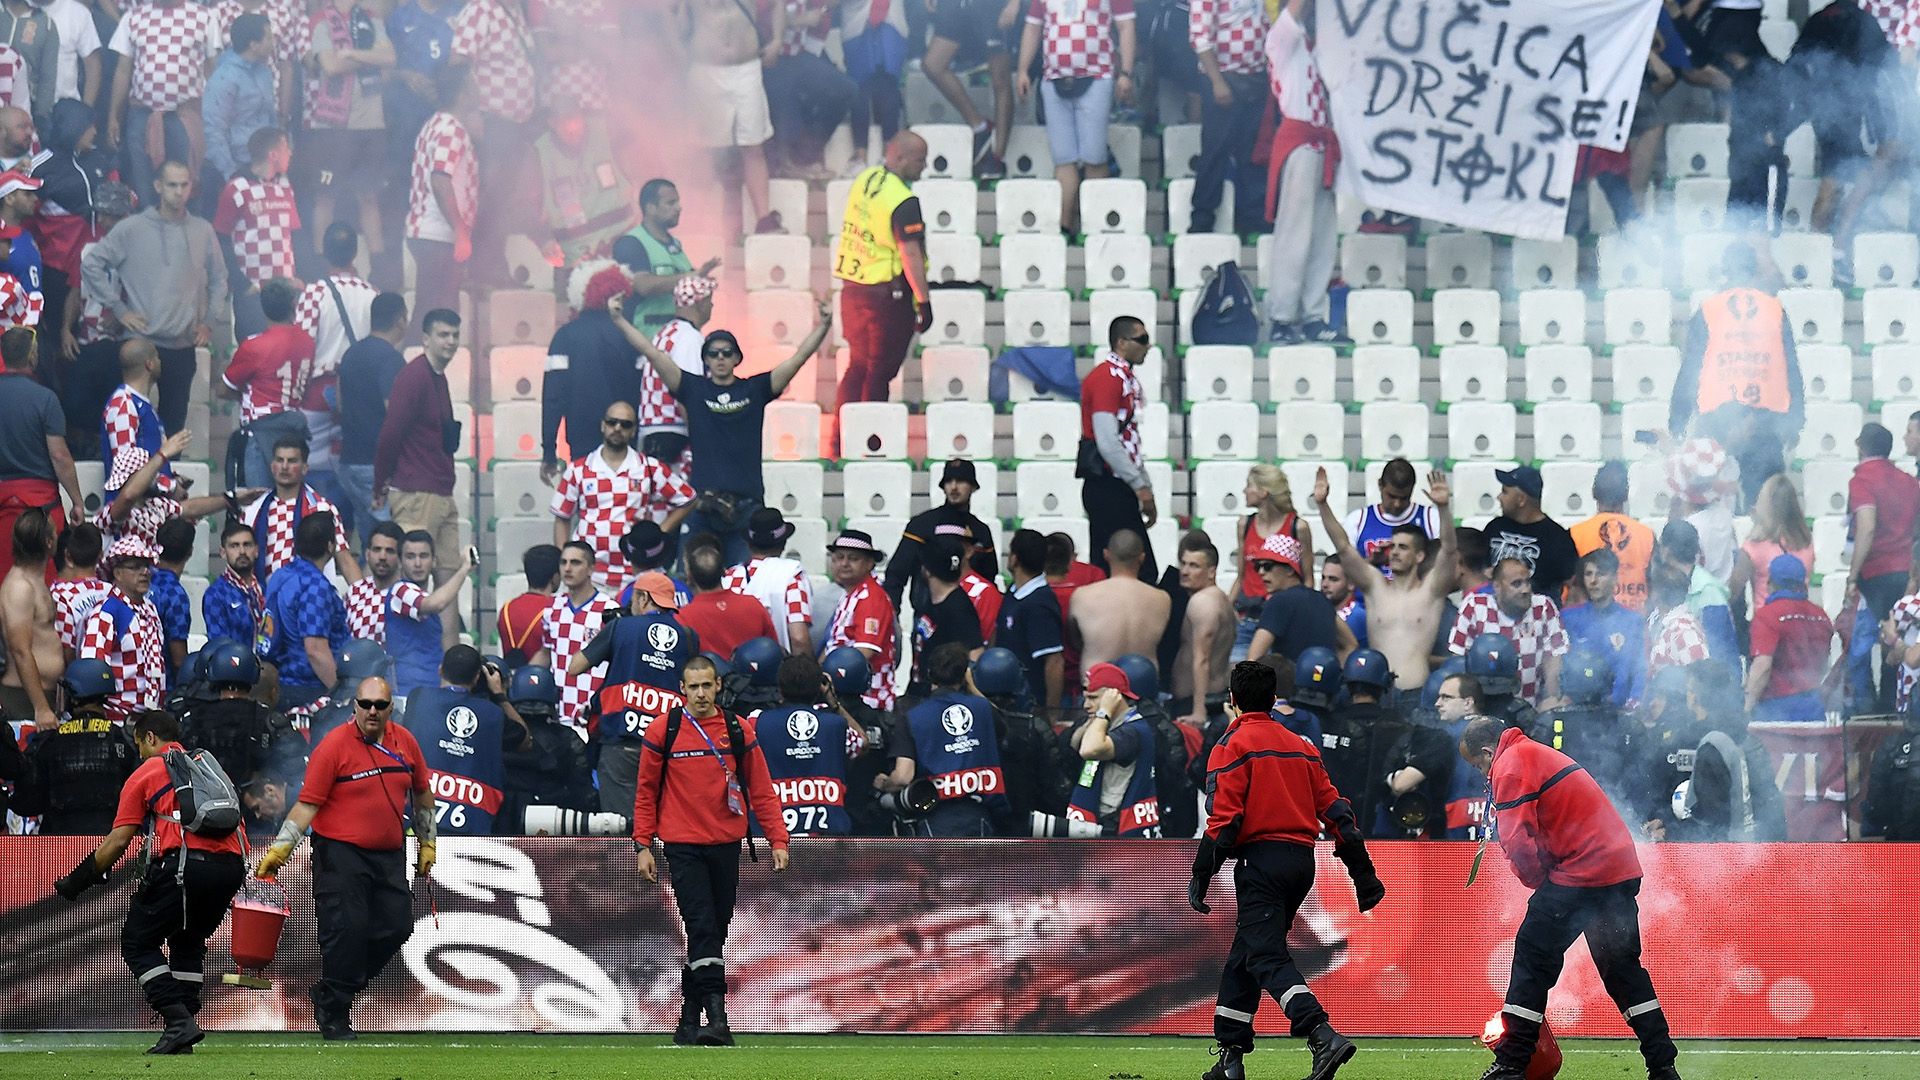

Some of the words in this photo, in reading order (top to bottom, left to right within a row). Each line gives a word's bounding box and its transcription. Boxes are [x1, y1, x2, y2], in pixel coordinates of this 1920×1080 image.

[429, 39, 441, 59] 5
[29, 265, 40, 289] 6
[434, 799, 466, 828] 76
[782, 806, 829, 832] 972
